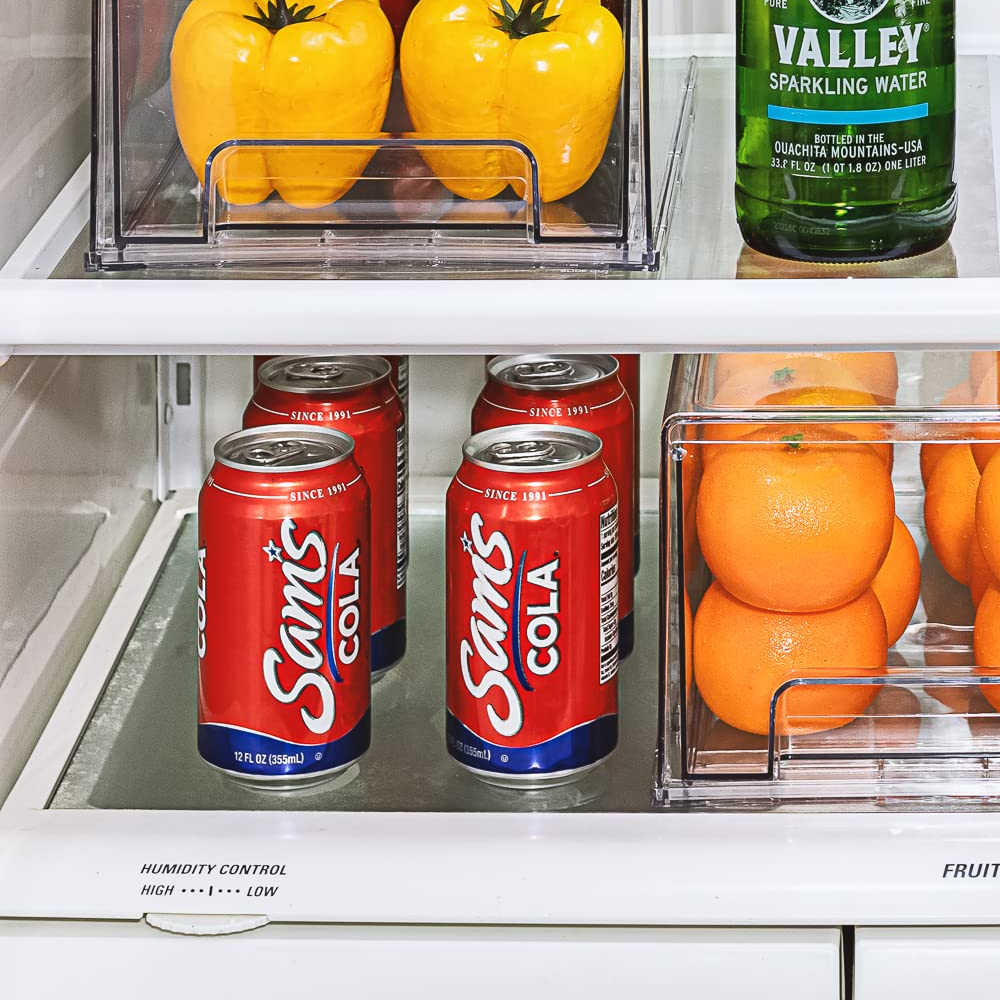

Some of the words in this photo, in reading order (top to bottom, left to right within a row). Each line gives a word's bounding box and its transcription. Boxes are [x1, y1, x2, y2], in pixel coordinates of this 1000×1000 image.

[769, 72, 868, 95] SPARKLING
[875, 71, 927, 94] WATER
[814, 133, 853, 145] BOTTLED
[855, 134, 865, 144] IN
[868, 133, 885, 144] THE
[774, 140, 827, 158] OUACHITA
[790, 160, 801, 172] FL
[804, 162, 815, 172] OZ
[822, 162, 830, 174] (1
[833, 162, 845, 173] QT
[848, 161, 862, 173] 1.8
[865, 161, 882, 173] OZ)
[884, 159, 902, 171] ONE
[905, 155, 927, 168] LITER
[290, 411, 323, 422] SINCE
[328, 410, 351, 421] 1991
[529, 407, 562, 418] SINCE
[567, 405, 589, 416] 1991
[289, 489, 325, 502] SINCE
[327, 482, 347, 497] 1991
[484, 488, 517, 501] SINCE
[522, 491, 547, 502] 1991
[338, 546, 360, 665] COLA
[527, 556, 560, 676] COLA
[234, 751, 243, 762] 12
[244, 752, 254, 764] FL
[256, 754, 267, 765] OZ
[268, 752, 305, 766] (355mL)
[464, 743, 491, 761] (355mL)
[140, 863, 216, 875] HUMIDITY
[219, 864, 288, 876] CONTROL
[140, 884, 175, 896] HIGH
[246, 886, 279, 897] LOW
